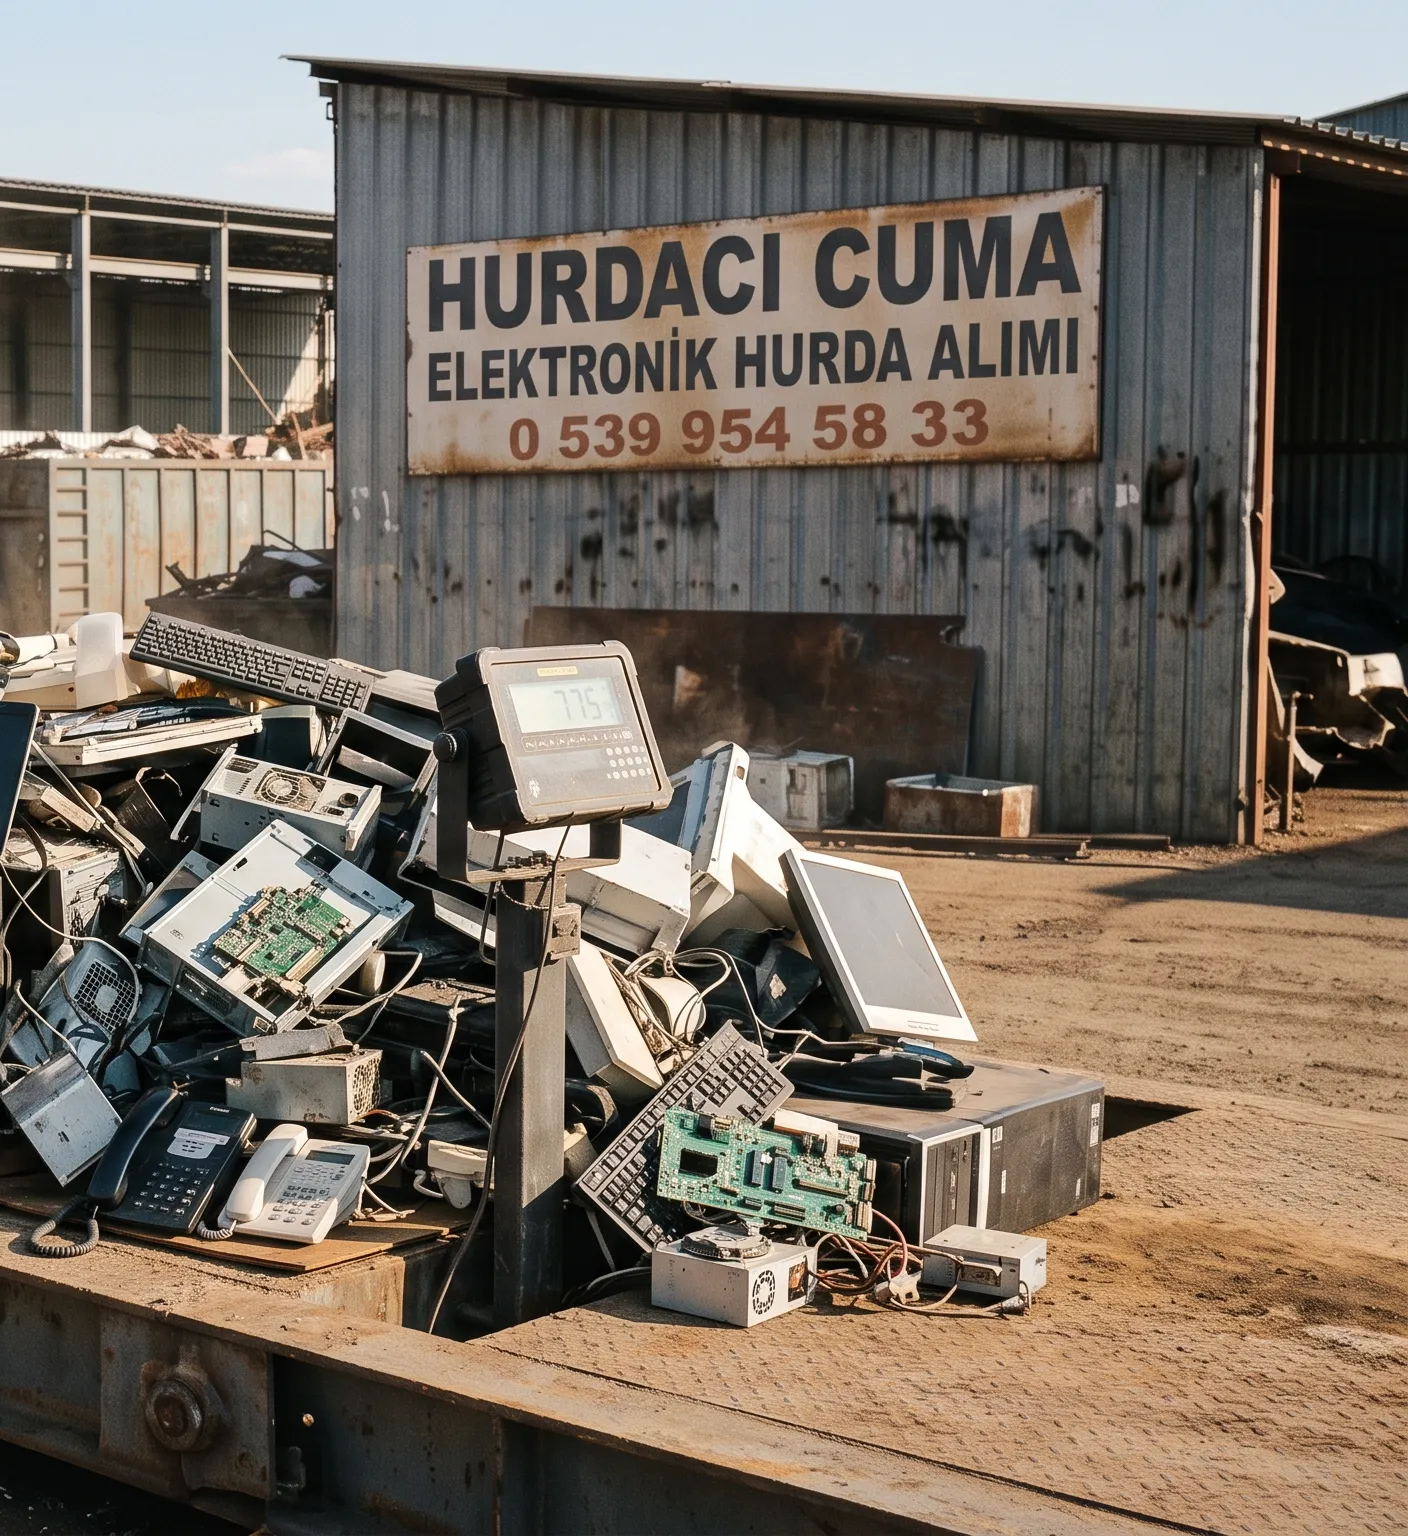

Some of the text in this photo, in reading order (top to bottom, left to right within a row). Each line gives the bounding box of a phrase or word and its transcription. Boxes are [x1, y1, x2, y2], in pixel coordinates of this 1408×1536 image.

[428, 211, 1083, 333] HURDACI CUMA
[428, 316, 1079, 402] ELEKTRONİK HURDA ALIMI
[509, 399, 989, 461] 0 539 954 58 33
[553, 685, 603, 721] 775
